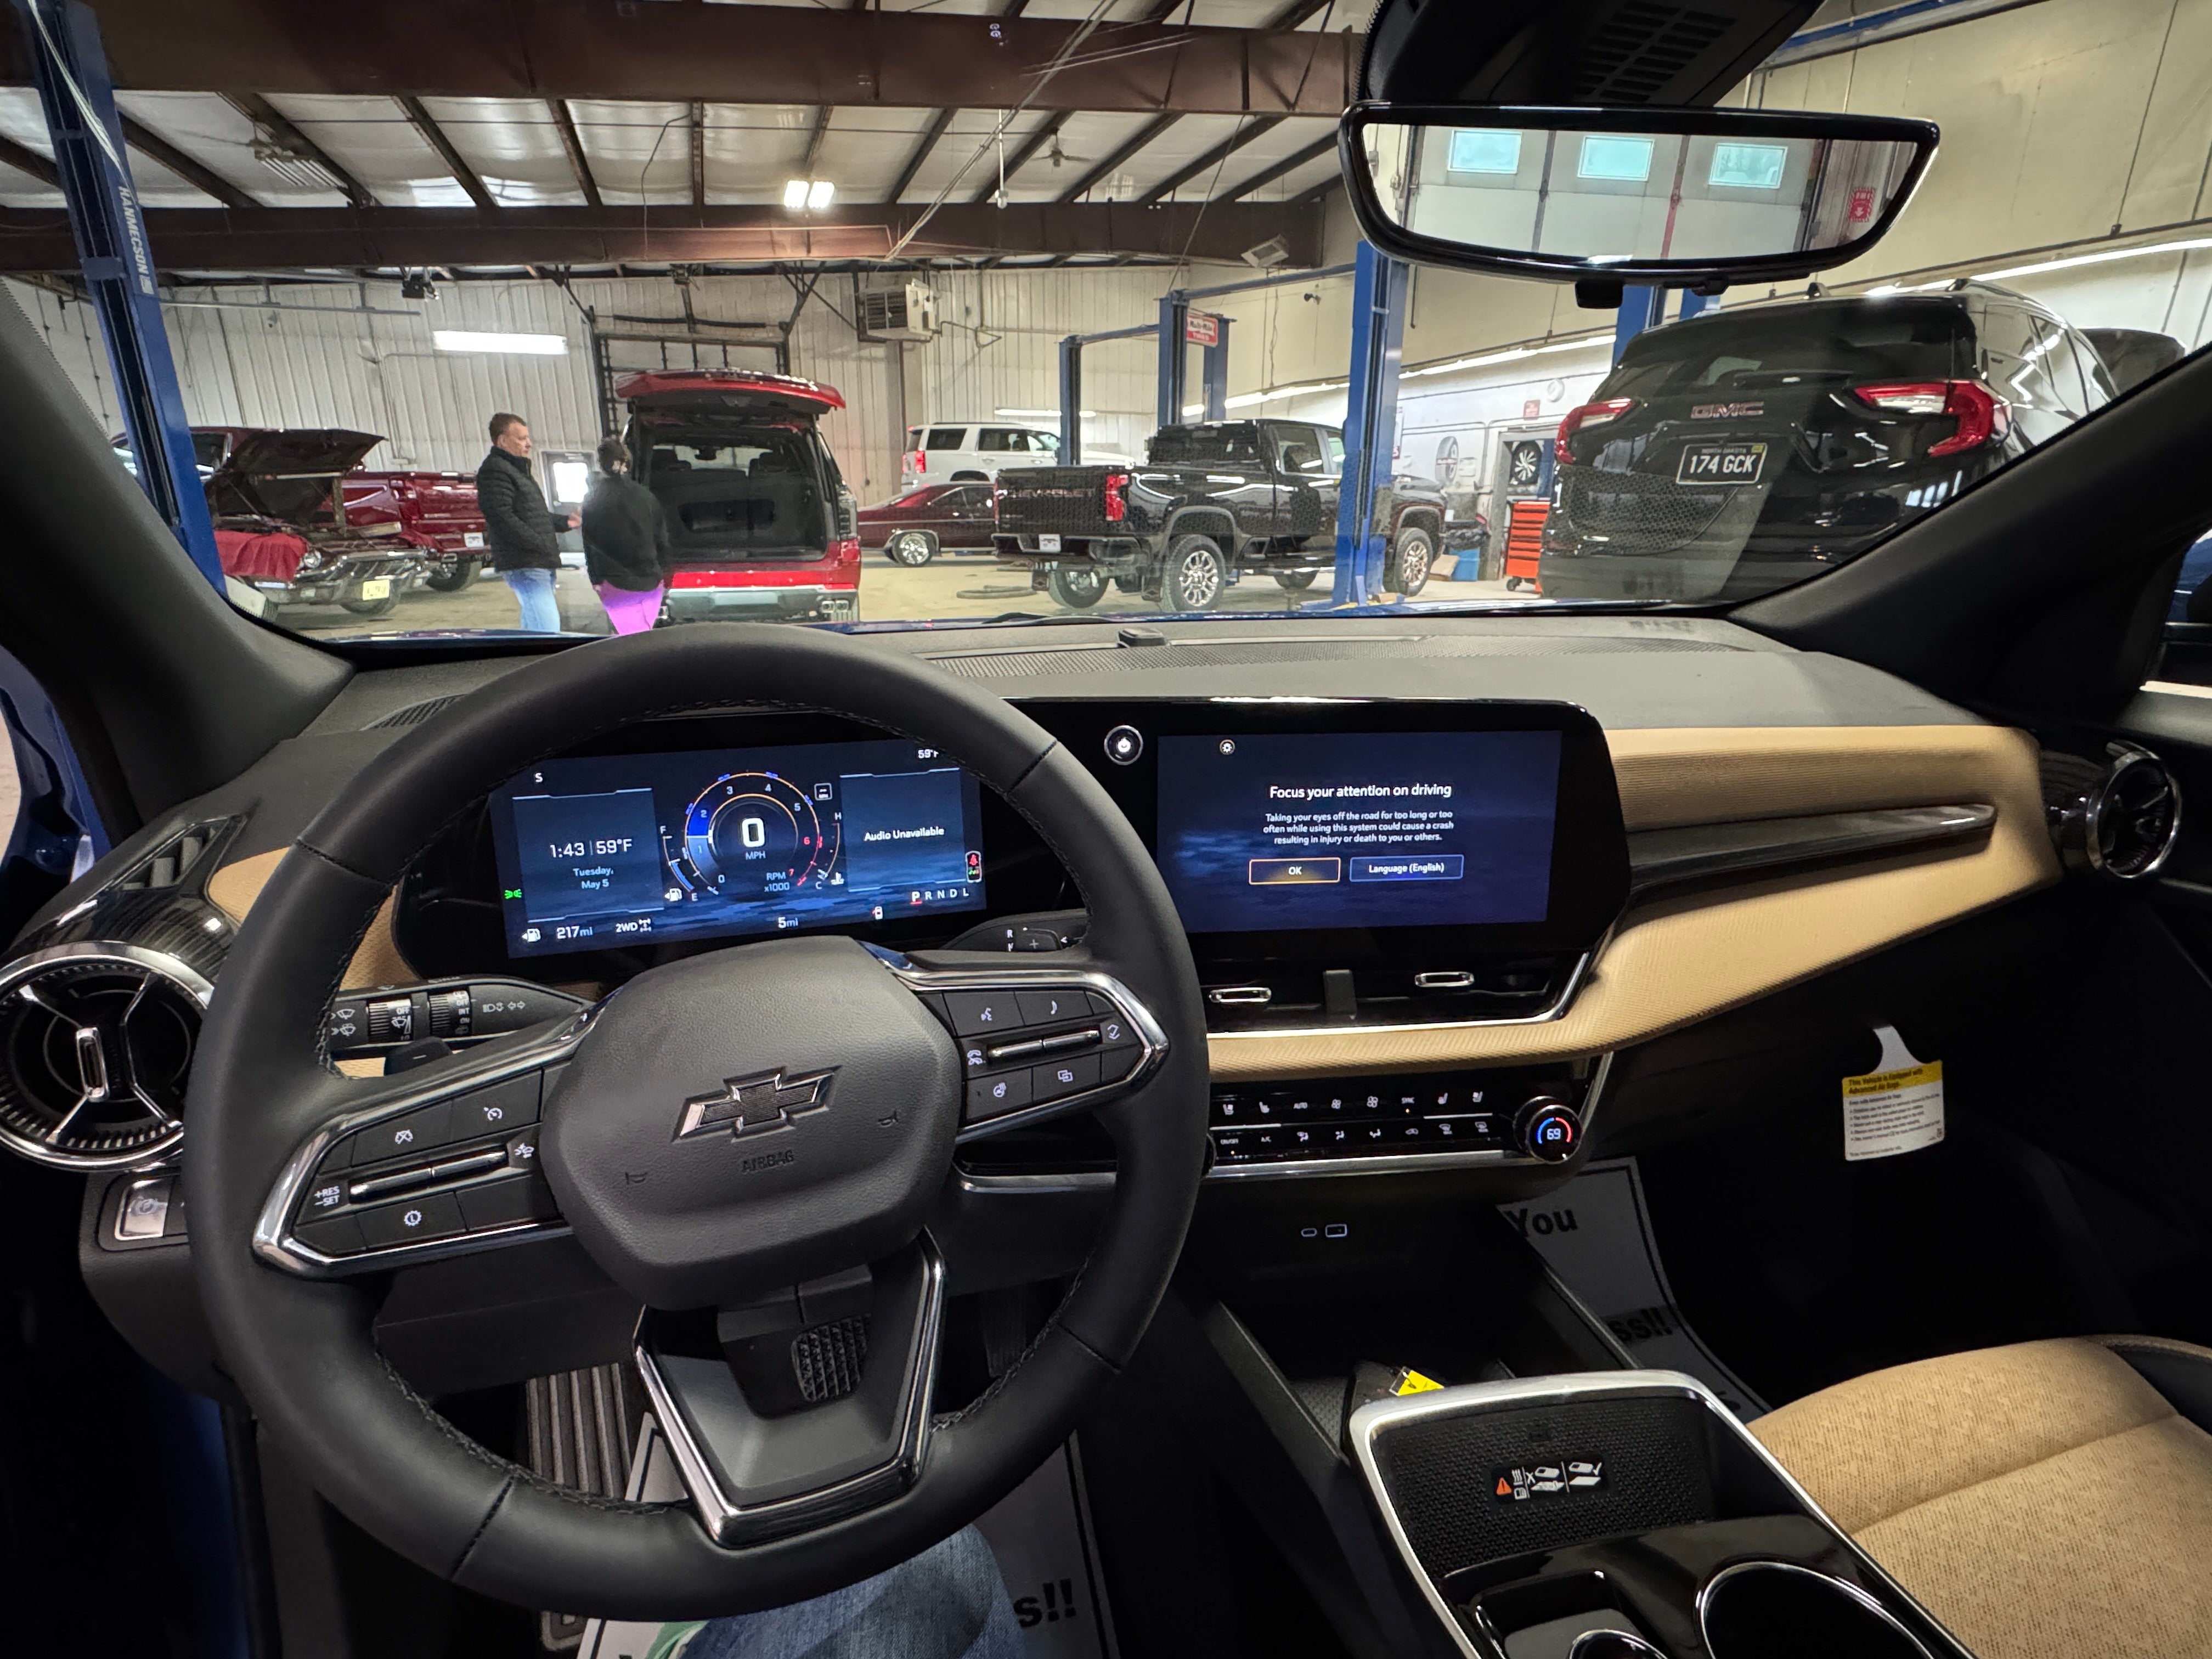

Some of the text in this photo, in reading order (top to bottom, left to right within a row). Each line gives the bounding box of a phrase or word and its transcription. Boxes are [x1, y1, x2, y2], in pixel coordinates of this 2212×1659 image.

[1691, 401, 1764, 419] GMC
[1690, 455, 1757, 473] 174 GCK
[535, 772, 543, 783] S
[726, 786, 733, 794] 3
[765, 784, 771, 792] 4
[1270, 783, 1452, 800] Focus your attention on driving
[794, 803, 801, 811] 5
[834, 812, 842, 820] H
[1265, 812, 1291, 823] Taking
[1293, 814, 1311, 823] your
[1313, 814, 1331, 822] eyes
[1333, 811, 1345, 821] off
[1346, 811, 1359, 820] the
[1361, 811, 1380, 820] road
[1381, 810, 1392, 819] for
[1394, 811, 1408, 819] too
[1409, 810, 1427, 821] long
[660, 826, 667, 834] F
[742, 817, 765, 847] 0
[1263, 824, 1285, 833] often
[1286, 823, 1308, 833] while
[1310, 824, 1331, 834] using
[1333, 823, 1347, 832] this
[1349, 823, 1377, 833] system
[1378, 822, 1401, 831] could
[1432, 821, 1454, 830] crash
[864, 826, 945, 842] Audio Unavailable
[1274, 835, 1309, 845] resulting
[1311, 835, 1318, 843] in
[1319, 835, 1342, 845] injury
[1353, 833, 1377, 843] death
[1414, 832, 1443, 841] others.
[803, 837, 810, 845] 6
[550, 839, 632, 858] 1:43 59°F
[698, 845, 702, 854] 1
[746, 851, 766, 860] MPH
[573, 866, 613, 877] Tuesday,
[1288, 866, 1302, 875] OK
[1369, 862, 1444, 874] Language (English)
[718, 874, 725, 883] 0
[766, 872, 786, 881] RPM
[582, 879, 609, 890] May 5
[764, 882, 790, 893] x1000
[815, 881, 822, 889] C
[692, 893, 698, 901] E
[912, 888, 969, 902] P R N D L
[616, 922, 638, 933] 2WD
[1007, 929, 1013, 938] R
[1547, 1128, 1561, 1140] 69
[742, 1150, 795, 1172] AIRBAG
[1506, 1208, 1578, 1238] You
